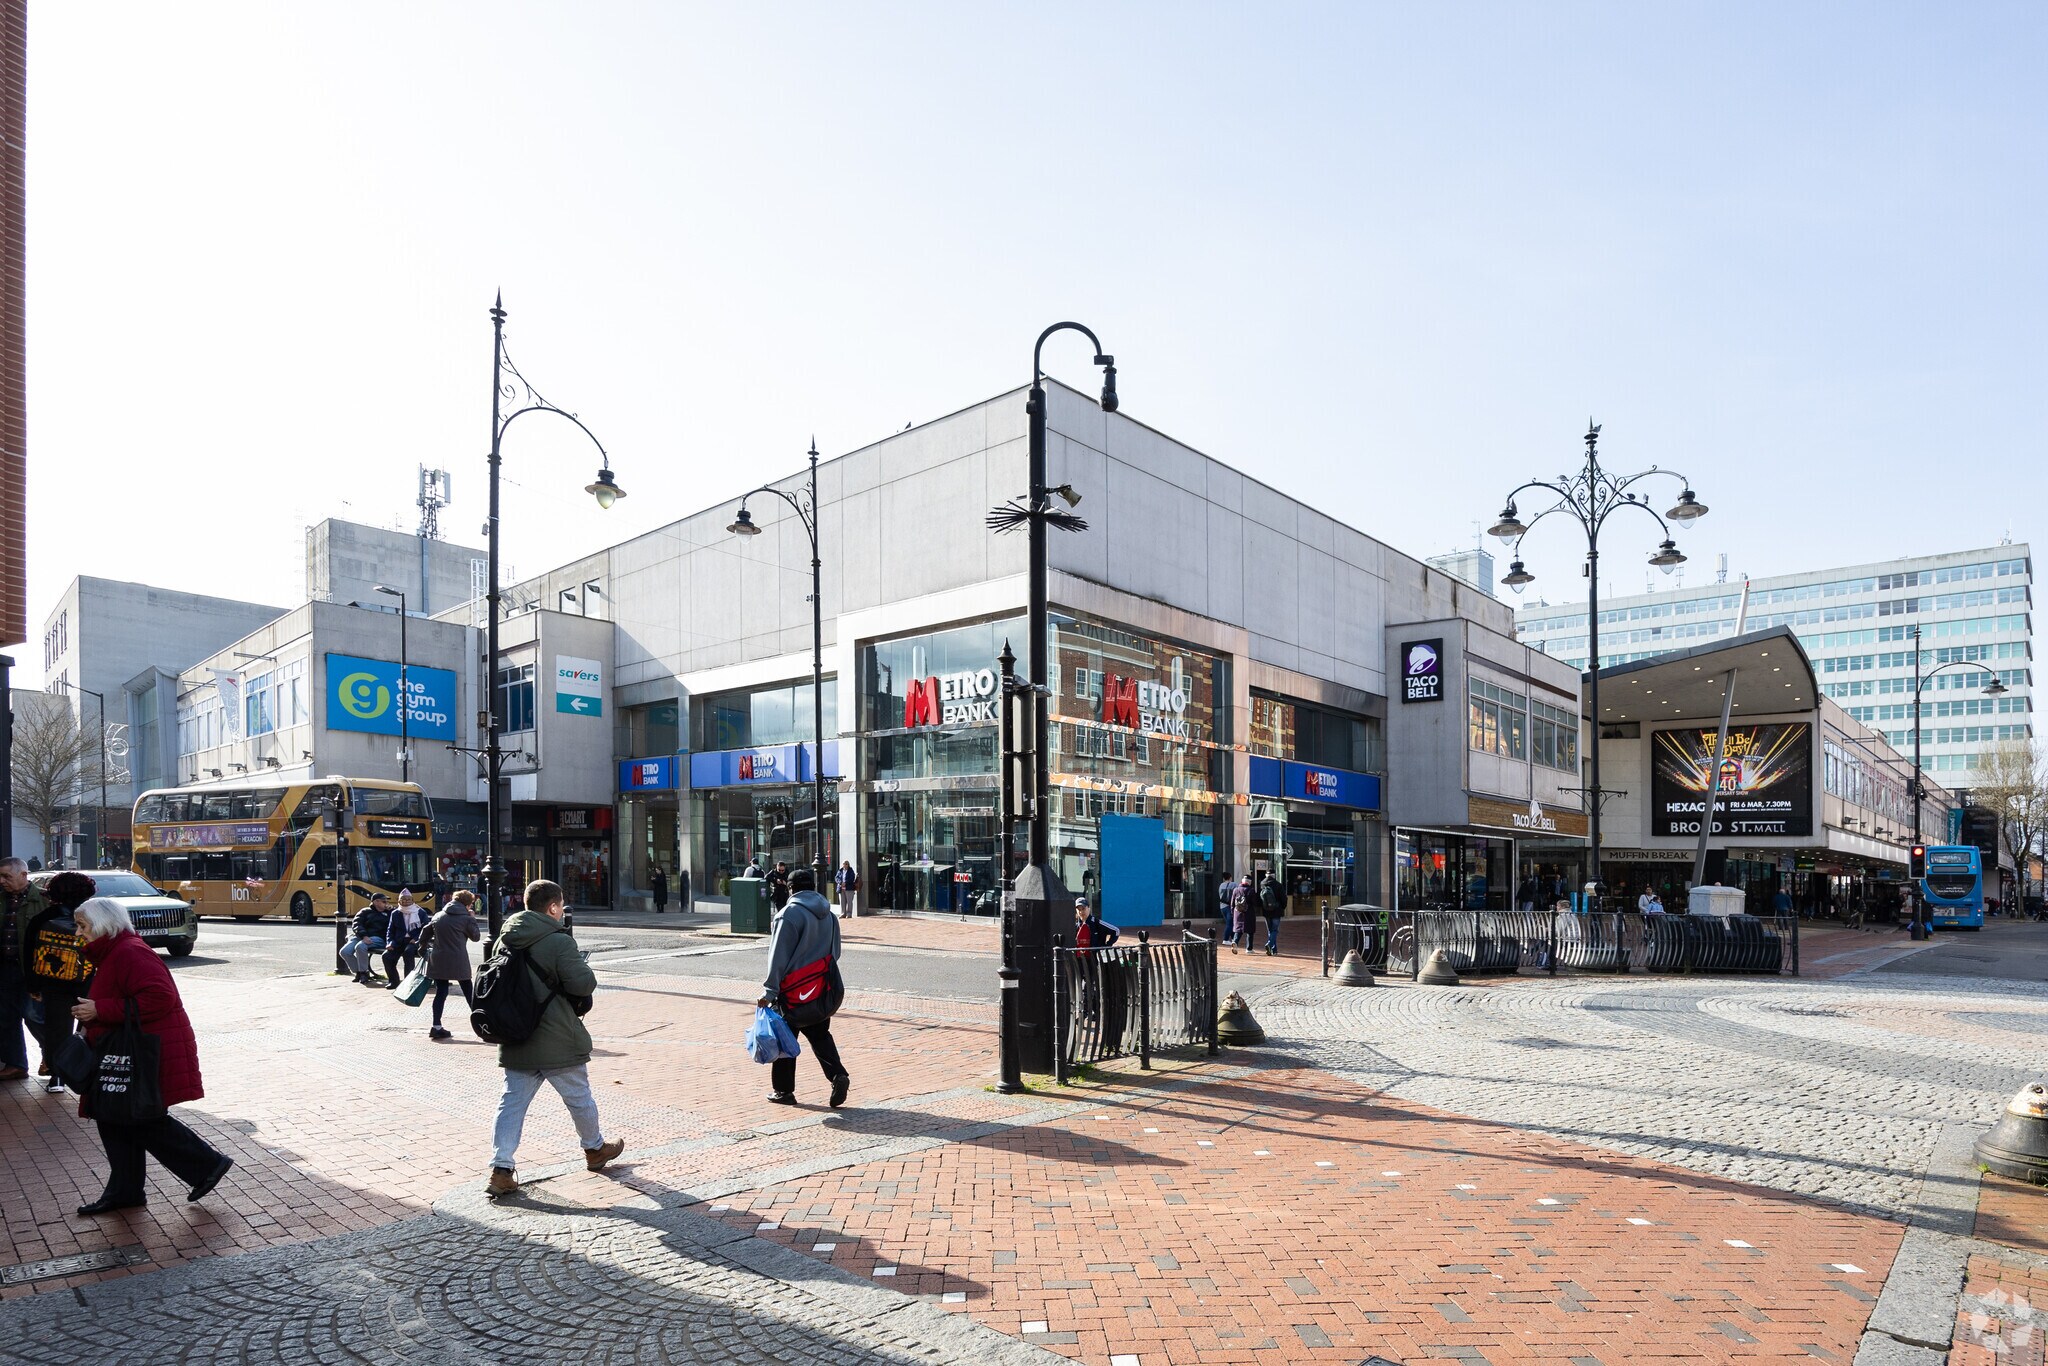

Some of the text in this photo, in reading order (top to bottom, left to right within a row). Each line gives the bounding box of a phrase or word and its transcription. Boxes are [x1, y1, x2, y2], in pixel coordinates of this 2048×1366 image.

[559, 669, 599, 682] savers
[1405, 675, 1438, 688] TACO
[396, 678, 425, 693] the
[1407, 686, 1438, 699] BELL
[396, 692, 435, 709] gym
[905, 668, 997, 728] METRO
[1102, 672, 1186, 729] METRO
[396, 708, 447, 727] group
[943, 700, 997, 725] BANK
[1141, 712, 1188, 741] BANK
[1735, 733, 1750, 745] Be
[631, 763, 660, 786] METRO
[739, 753, 776, 780] METRO
[754, 768, 774, 778] BANK
[643, 776, 659, 785] BANK
[1305, 769, 1338, 796] METRO
[1319, 787, 1338, 798] BANK
[1512, 813, 1557, 831] TACO BELL
[1754, 825, 1786, 833] MALL
[1609, 851, 1689, 860] MUFFIN BREAK
[231, 884, 250, 901] lion
